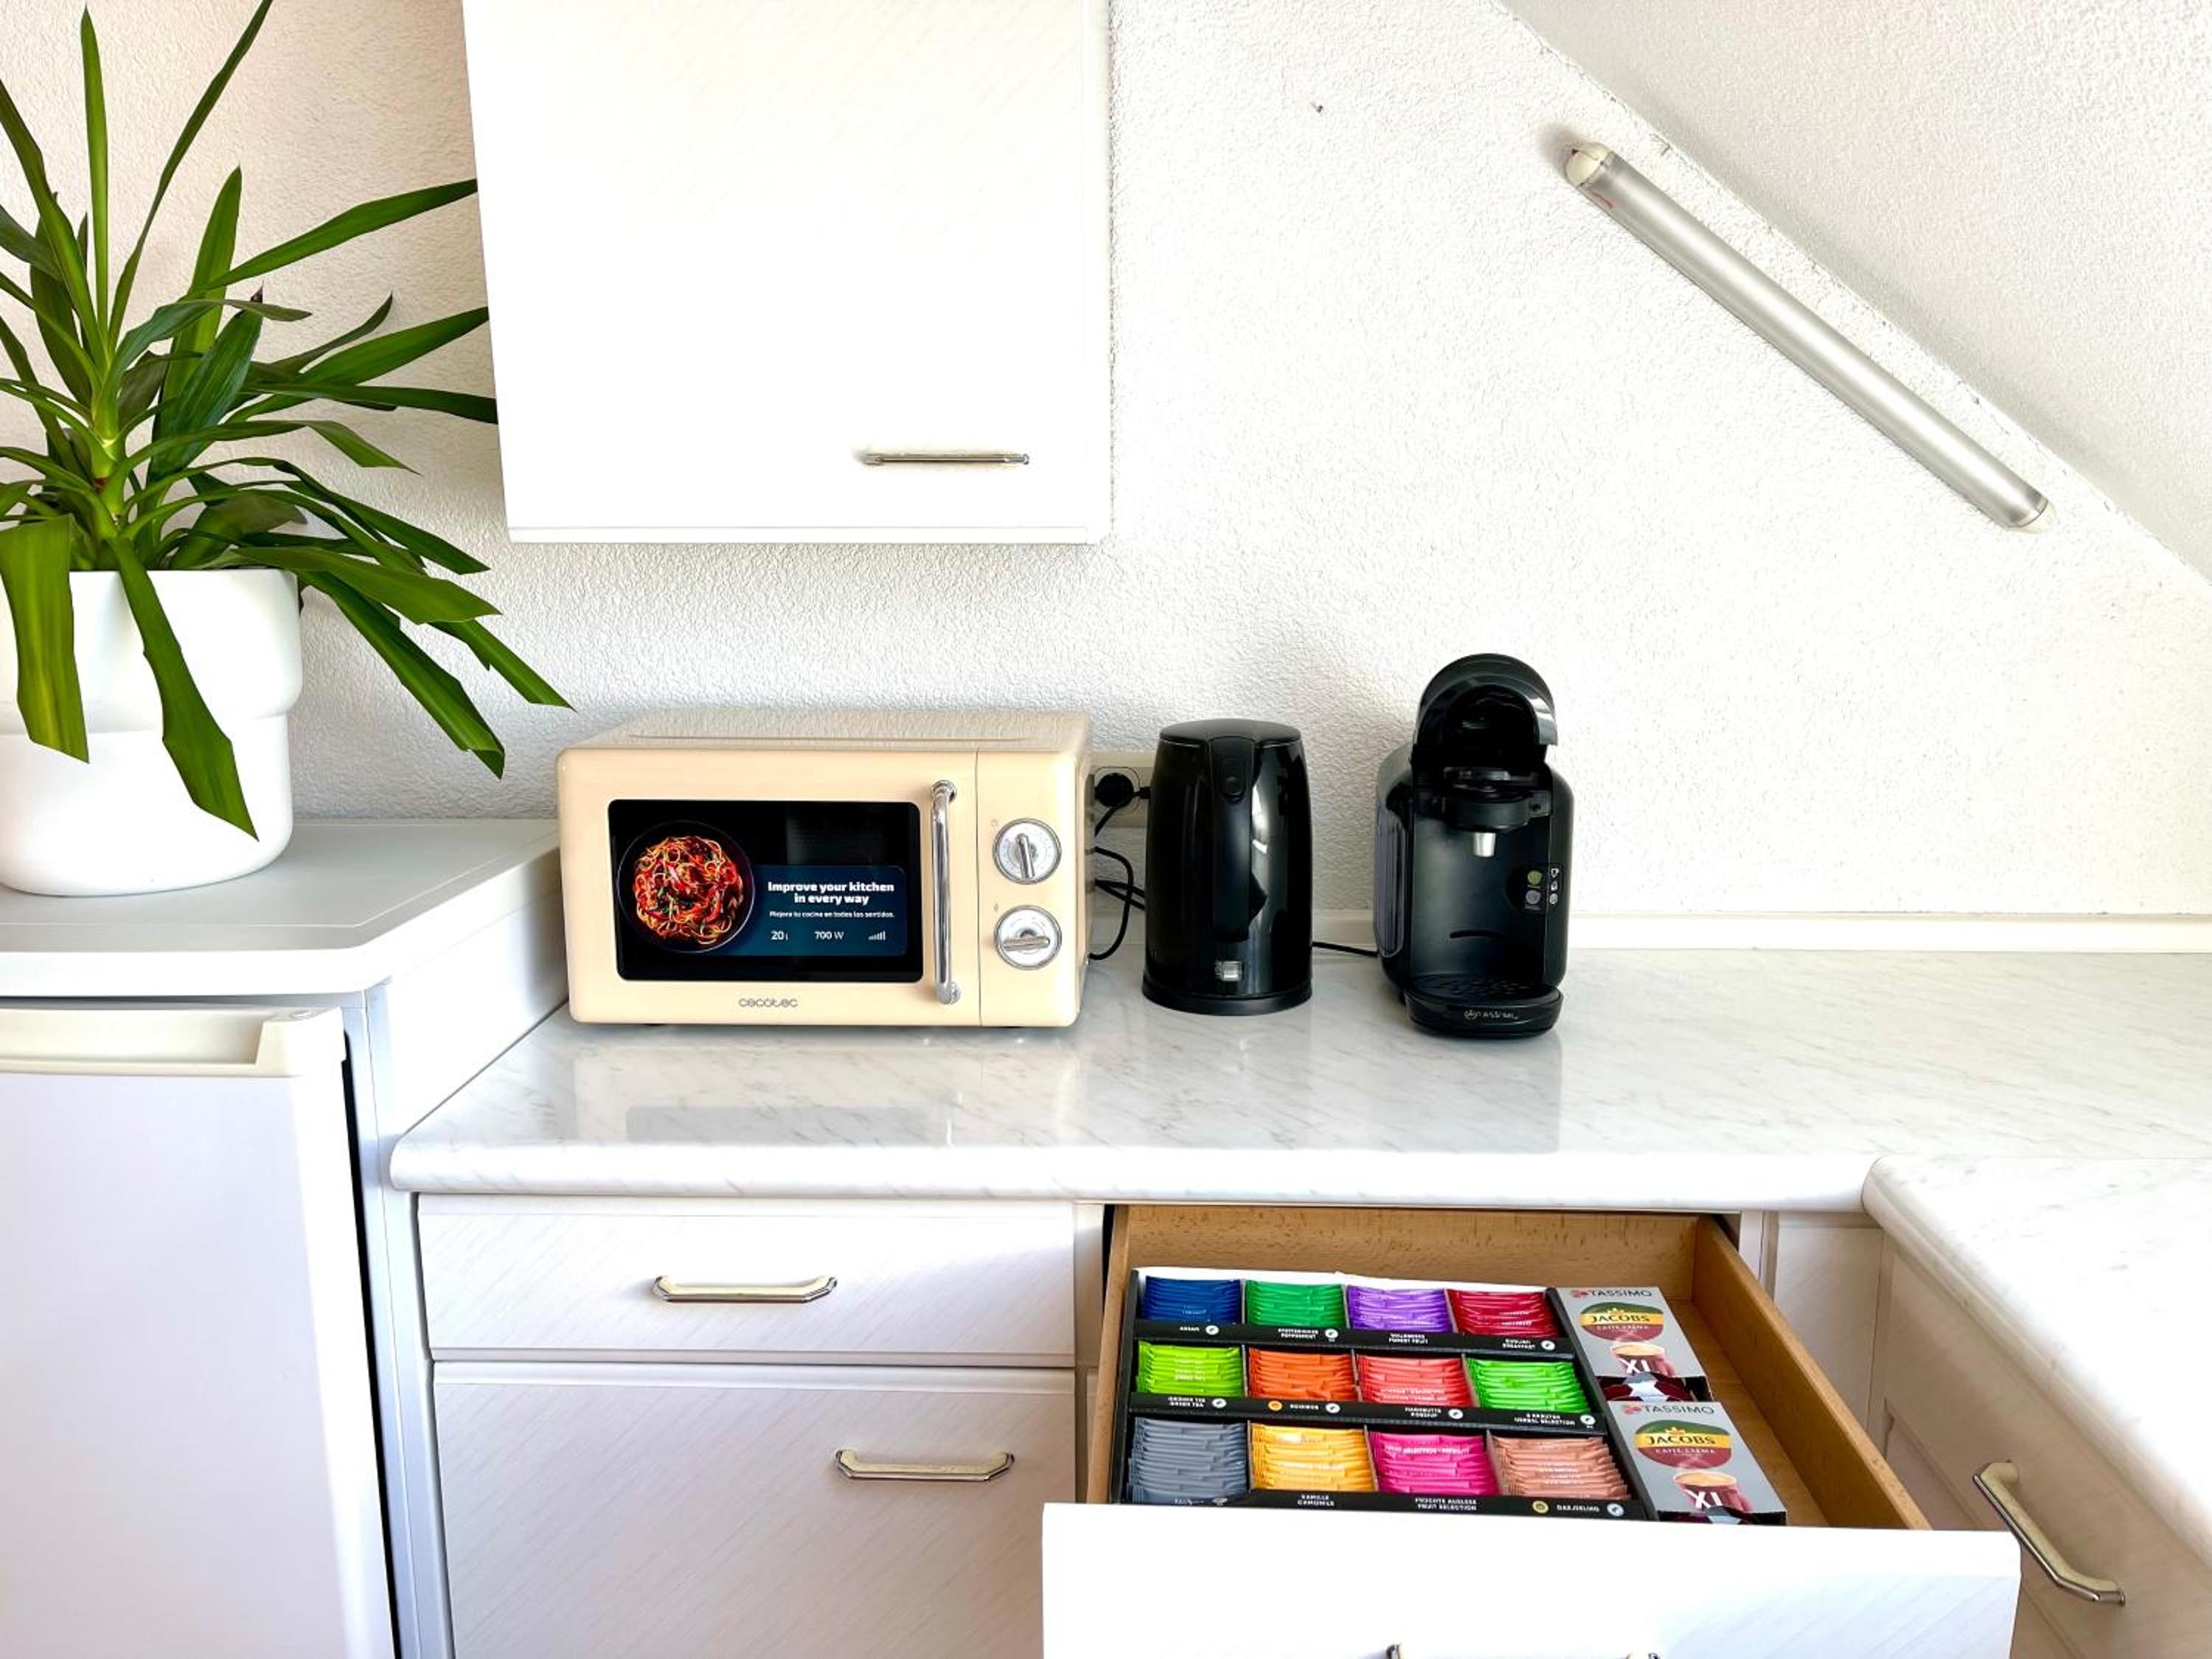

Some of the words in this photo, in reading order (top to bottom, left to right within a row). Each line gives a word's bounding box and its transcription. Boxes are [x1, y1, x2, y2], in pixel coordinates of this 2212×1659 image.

[768, 882, 817, 893] Improve
[819, 884, 847, 894] your
[849, 882, 894, 891] kitchen
[794, 894, 806, 903] in
[807, 895, 842, 905] every
[844, 896, 869, 905] way
[815, 931, 832, 940] 700
[834, 931, 844, 940] W
[738, 998, 799, 1008] cecotec
[1644, 1405, 1714, 1413] TASSIMO
[1646, 1436, 1717, 1444] JACOBS
